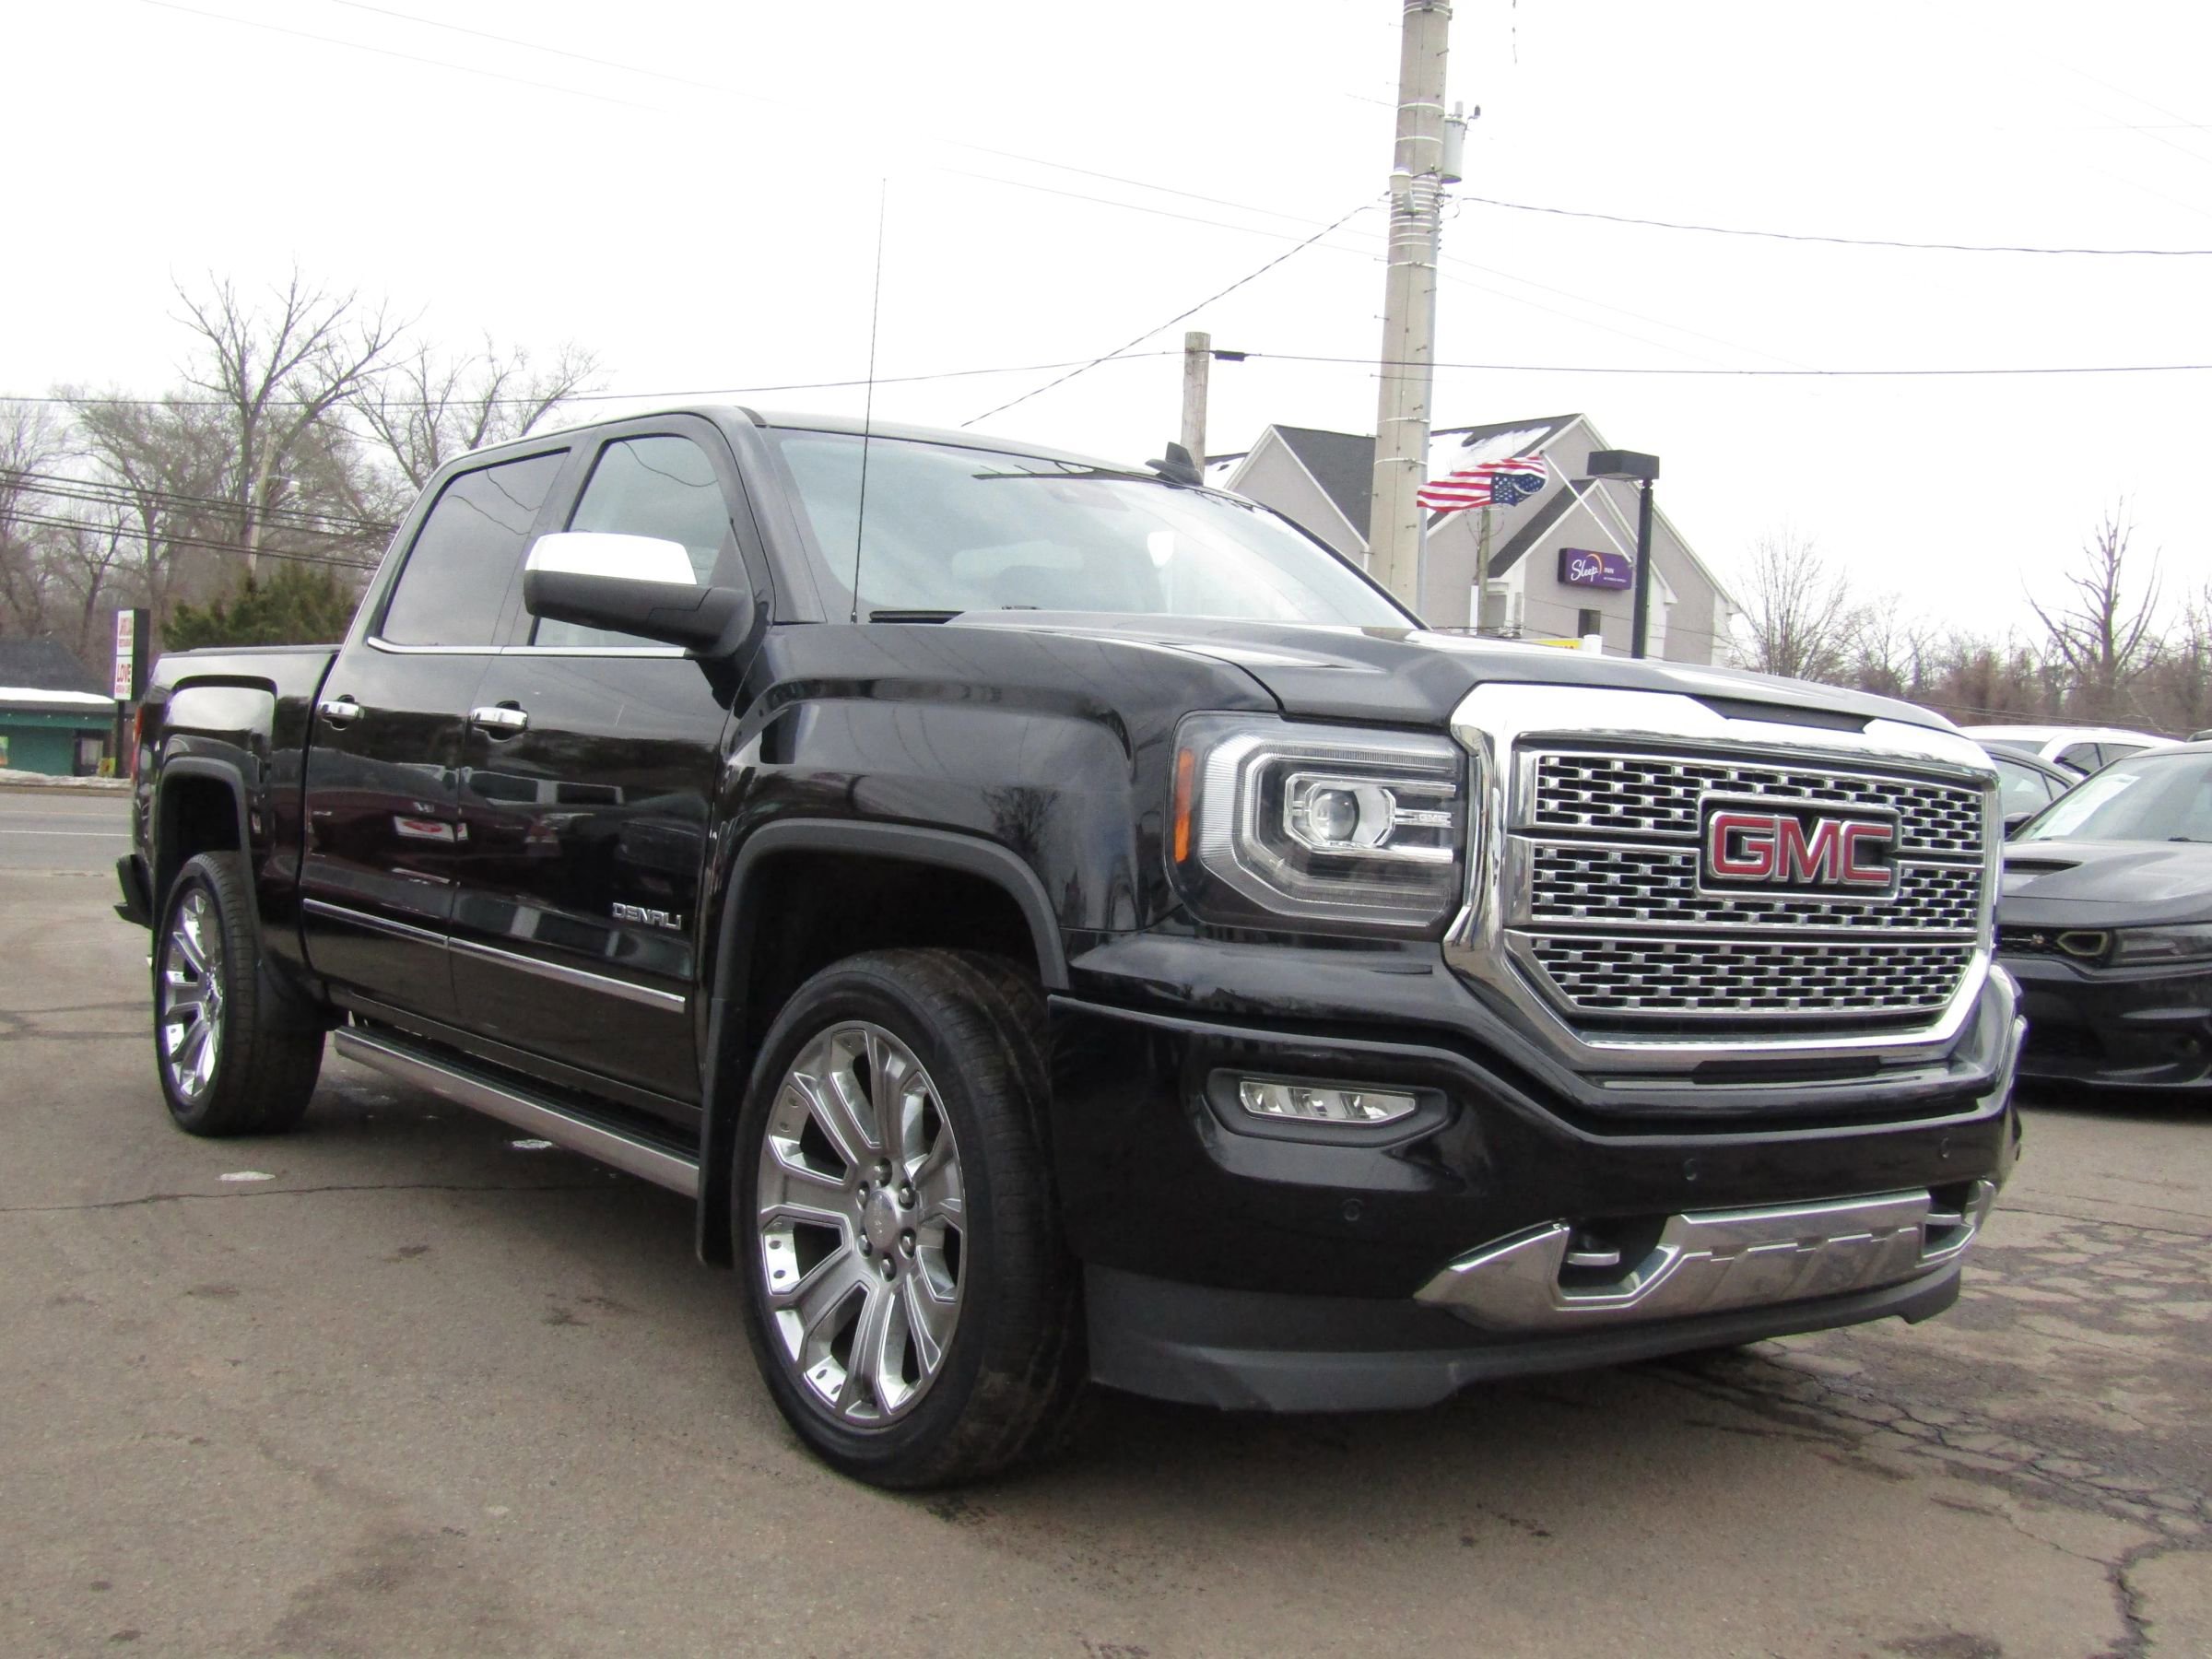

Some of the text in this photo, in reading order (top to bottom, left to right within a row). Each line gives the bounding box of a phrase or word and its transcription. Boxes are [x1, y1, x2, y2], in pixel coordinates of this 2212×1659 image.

[1571, 559, 1599, 582] Sleep
[1709, 810, 1893, 887] GMC
[612, 902, 682, 931] DENALI
